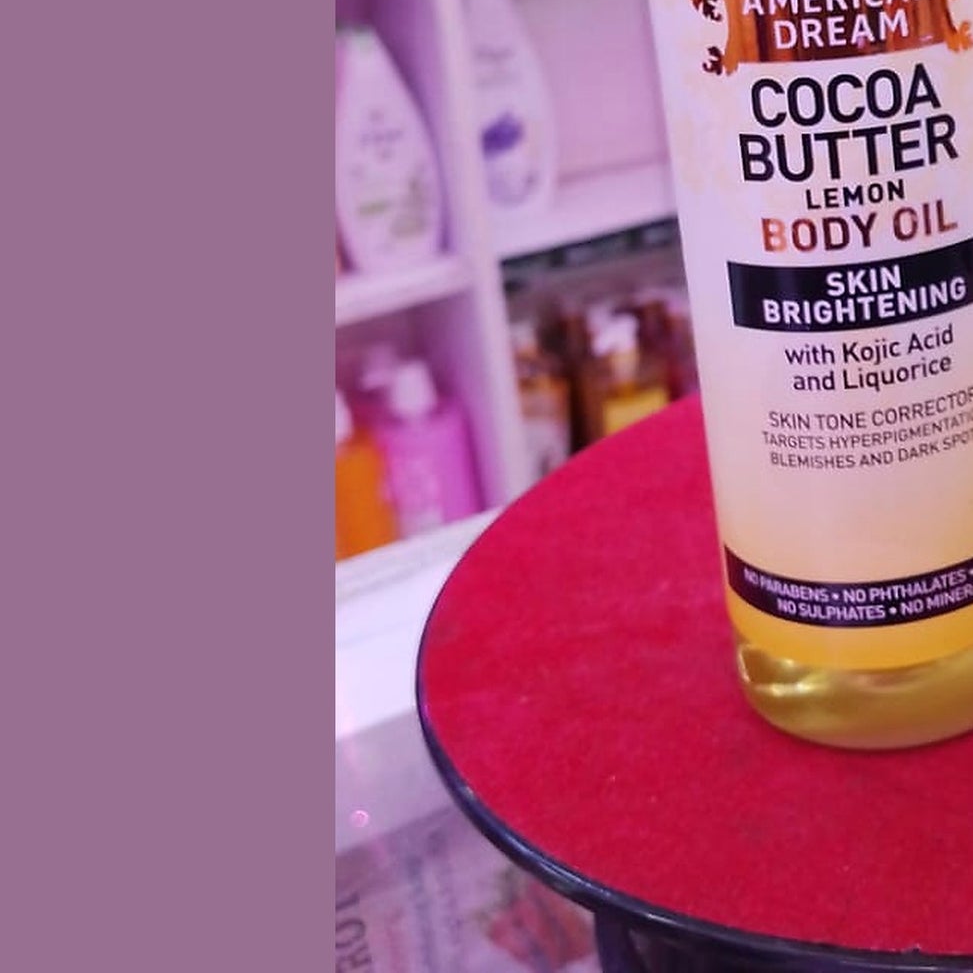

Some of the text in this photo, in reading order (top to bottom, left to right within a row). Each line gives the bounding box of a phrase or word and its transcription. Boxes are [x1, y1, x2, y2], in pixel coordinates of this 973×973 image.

[774, 9, 910, 49] DREAM
[751, 63, 941, 127] COCOA
[739, 114, 958, 182] BUTTER
[806, 179, 905, 210] LEMON
[761, 199, 958, 253] BODY OIL
[826, 264, 902, 297] SKIN
[763, 276, 967, 324] BRIGHTENING
[785, 323, 954, 365] with Kojic Acid
[793, 355, 952, 392] and Liquorice
[768, 411, 810, 430] SKIN
[816, 411, 866, 430] TONE
[761, 431, 825, 450] TARGETS
[770, 451, 856, 469] BLEMISHES
[859, 451, 894, 467] AND
[899, 441, 940, 461] DARK
[760, 575, 829, 602] PARABENS
[842, 589, 867, 604] NO
[869, 568, 967, 602] PHTHALATES
[776, 598, 797, 615] NO
[798, 603, 886, 620] SULPHATES
[900, 600, 924, 616] NO
